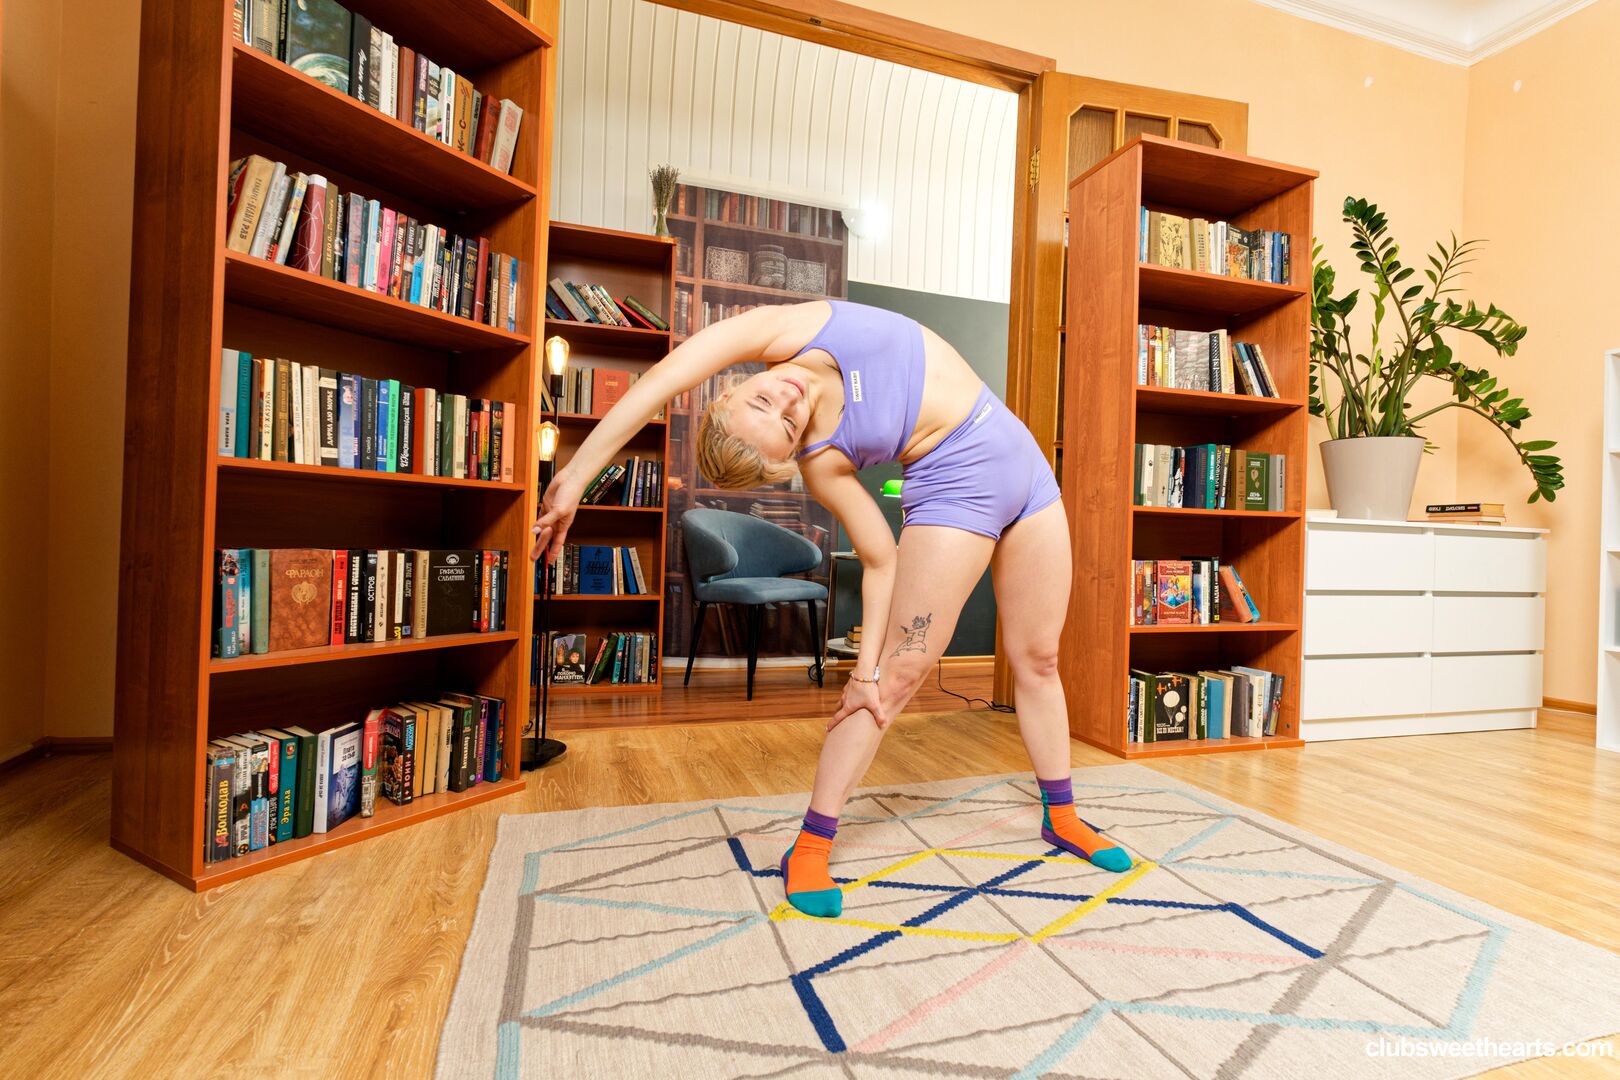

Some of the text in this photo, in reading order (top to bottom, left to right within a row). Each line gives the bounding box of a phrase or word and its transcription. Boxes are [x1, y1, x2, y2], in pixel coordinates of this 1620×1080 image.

[327, 411, 333, 423] ДЮ
[285, 568, 324, 579] ФАРАОН
[439, 568, 465, 576] РАФАЭЛЬ
[367, 576, 375, 602] ОСТРОВ
[216, 780, 228, 836] Волкодав
[280, 789, 291, 823] Эра зла
